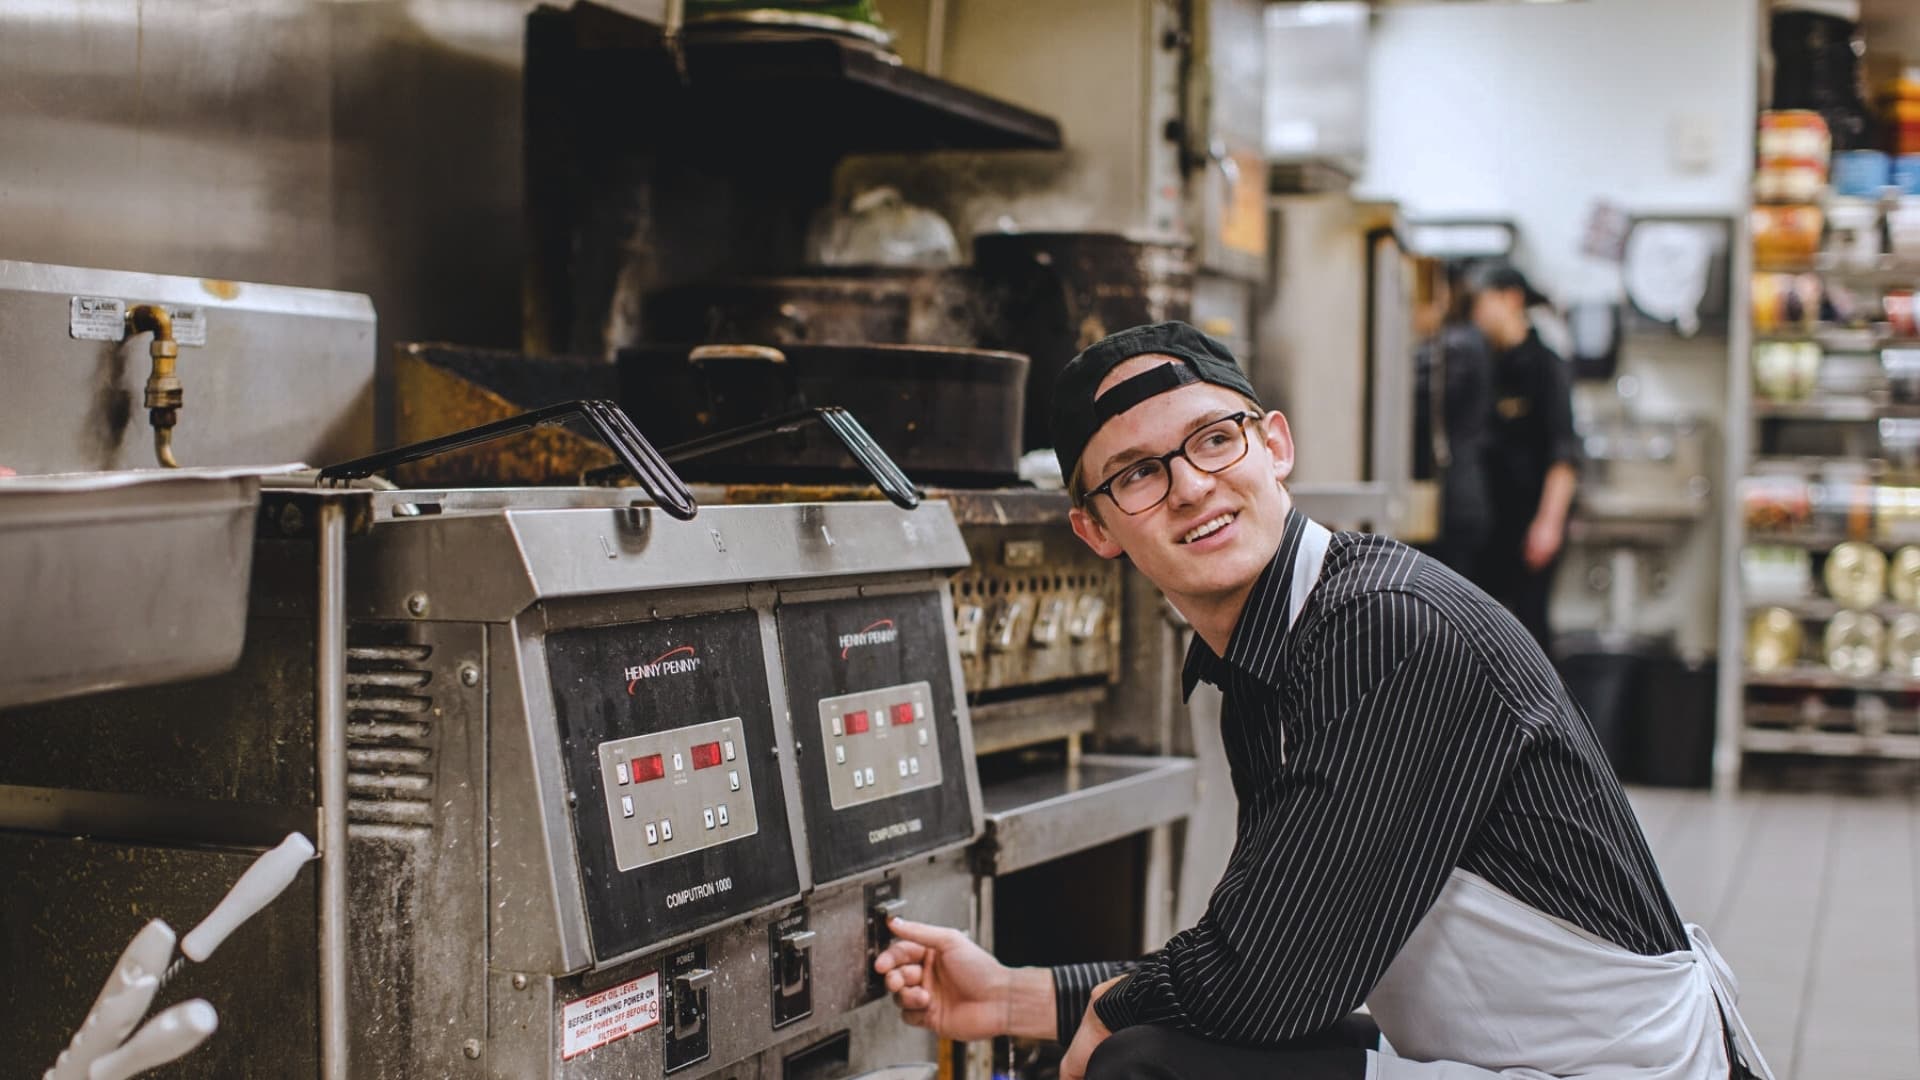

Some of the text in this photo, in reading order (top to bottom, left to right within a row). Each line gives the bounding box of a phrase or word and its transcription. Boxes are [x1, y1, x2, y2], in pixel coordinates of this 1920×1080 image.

[624, 658, 697, 681] HENNY PENNY
[666, 877, 733, 909] COMPUTRON 1000
[676, 952, 695, 965] POWER
[568, 988, 655, 1029] BEFORE TURNING POWER ON
[585, 982, 639, 1009] CHECK OIL LEVEL
[575, 1003, 648, 1038] SHUT POWER OFF BEFORE
[598, 1023, 628, 1041] FILTERING
